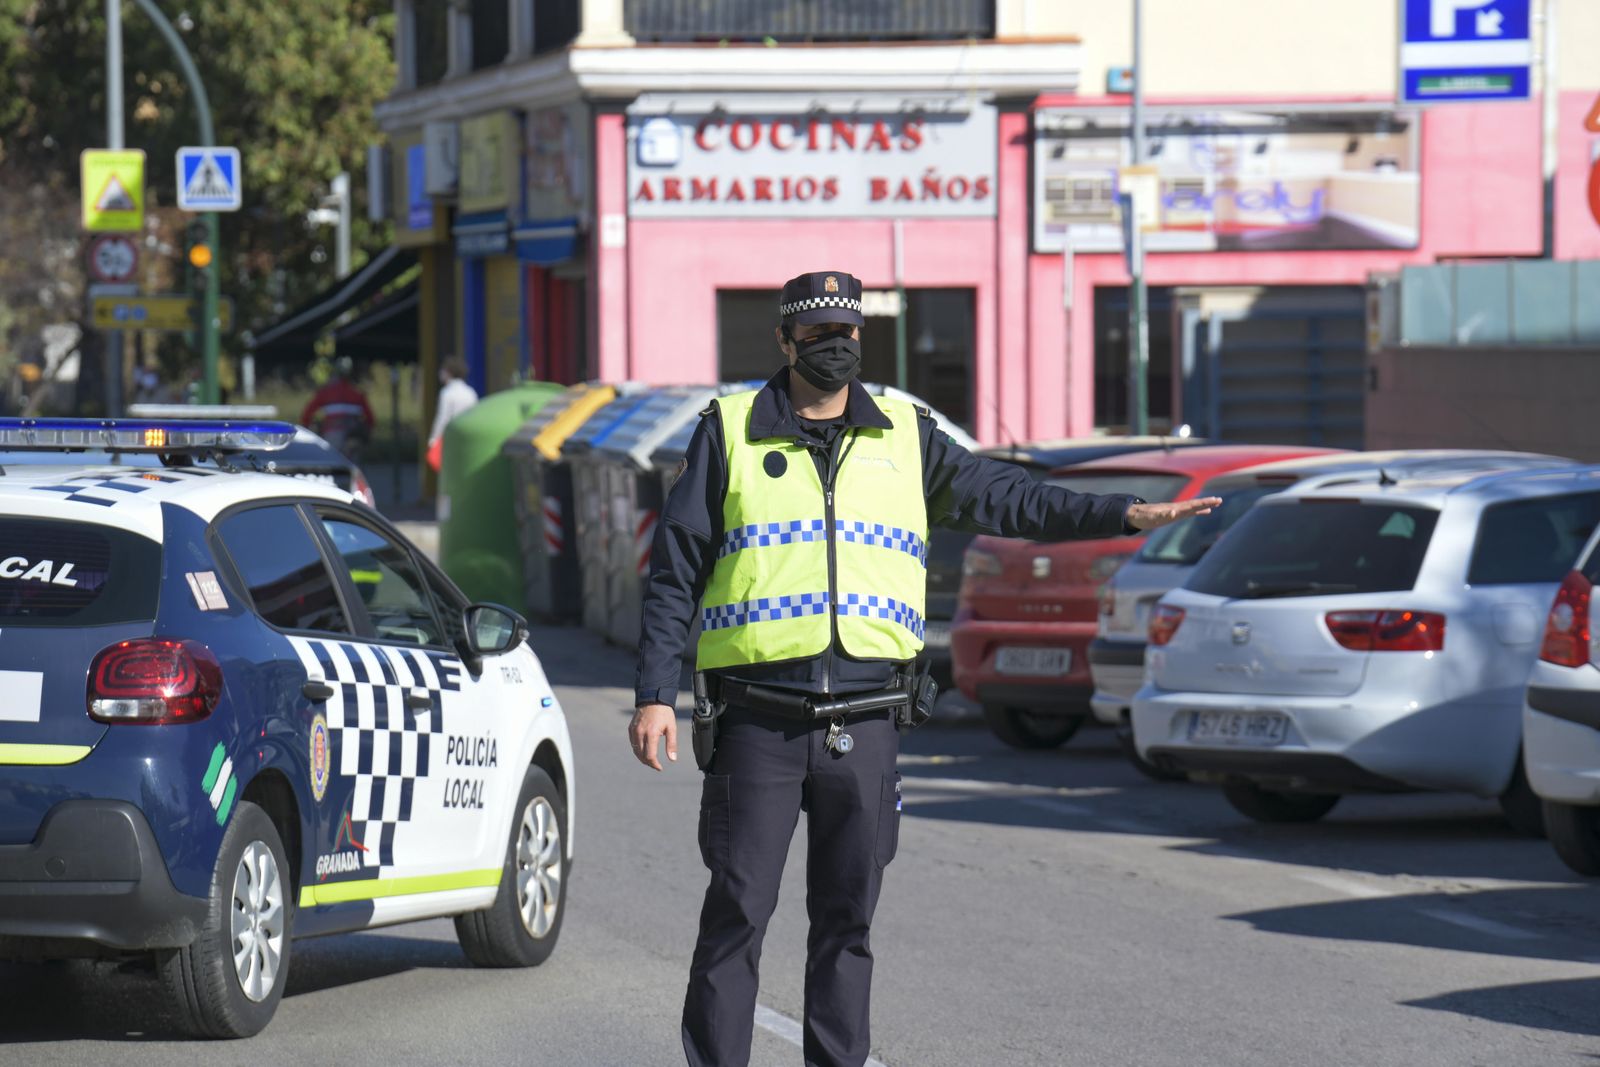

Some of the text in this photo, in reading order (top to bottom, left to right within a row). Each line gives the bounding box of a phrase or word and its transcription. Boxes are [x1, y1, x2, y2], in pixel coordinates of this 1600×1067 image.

[694, 118, 924, 152] COCINAS
[635, 166, 992, 203] ARMARIOS BAÑOS
[446, 729, 498, 768] POLICÍA
[443, 777, 485, 809] LOCAL
[316, 850, 361, 875] GRANADA
